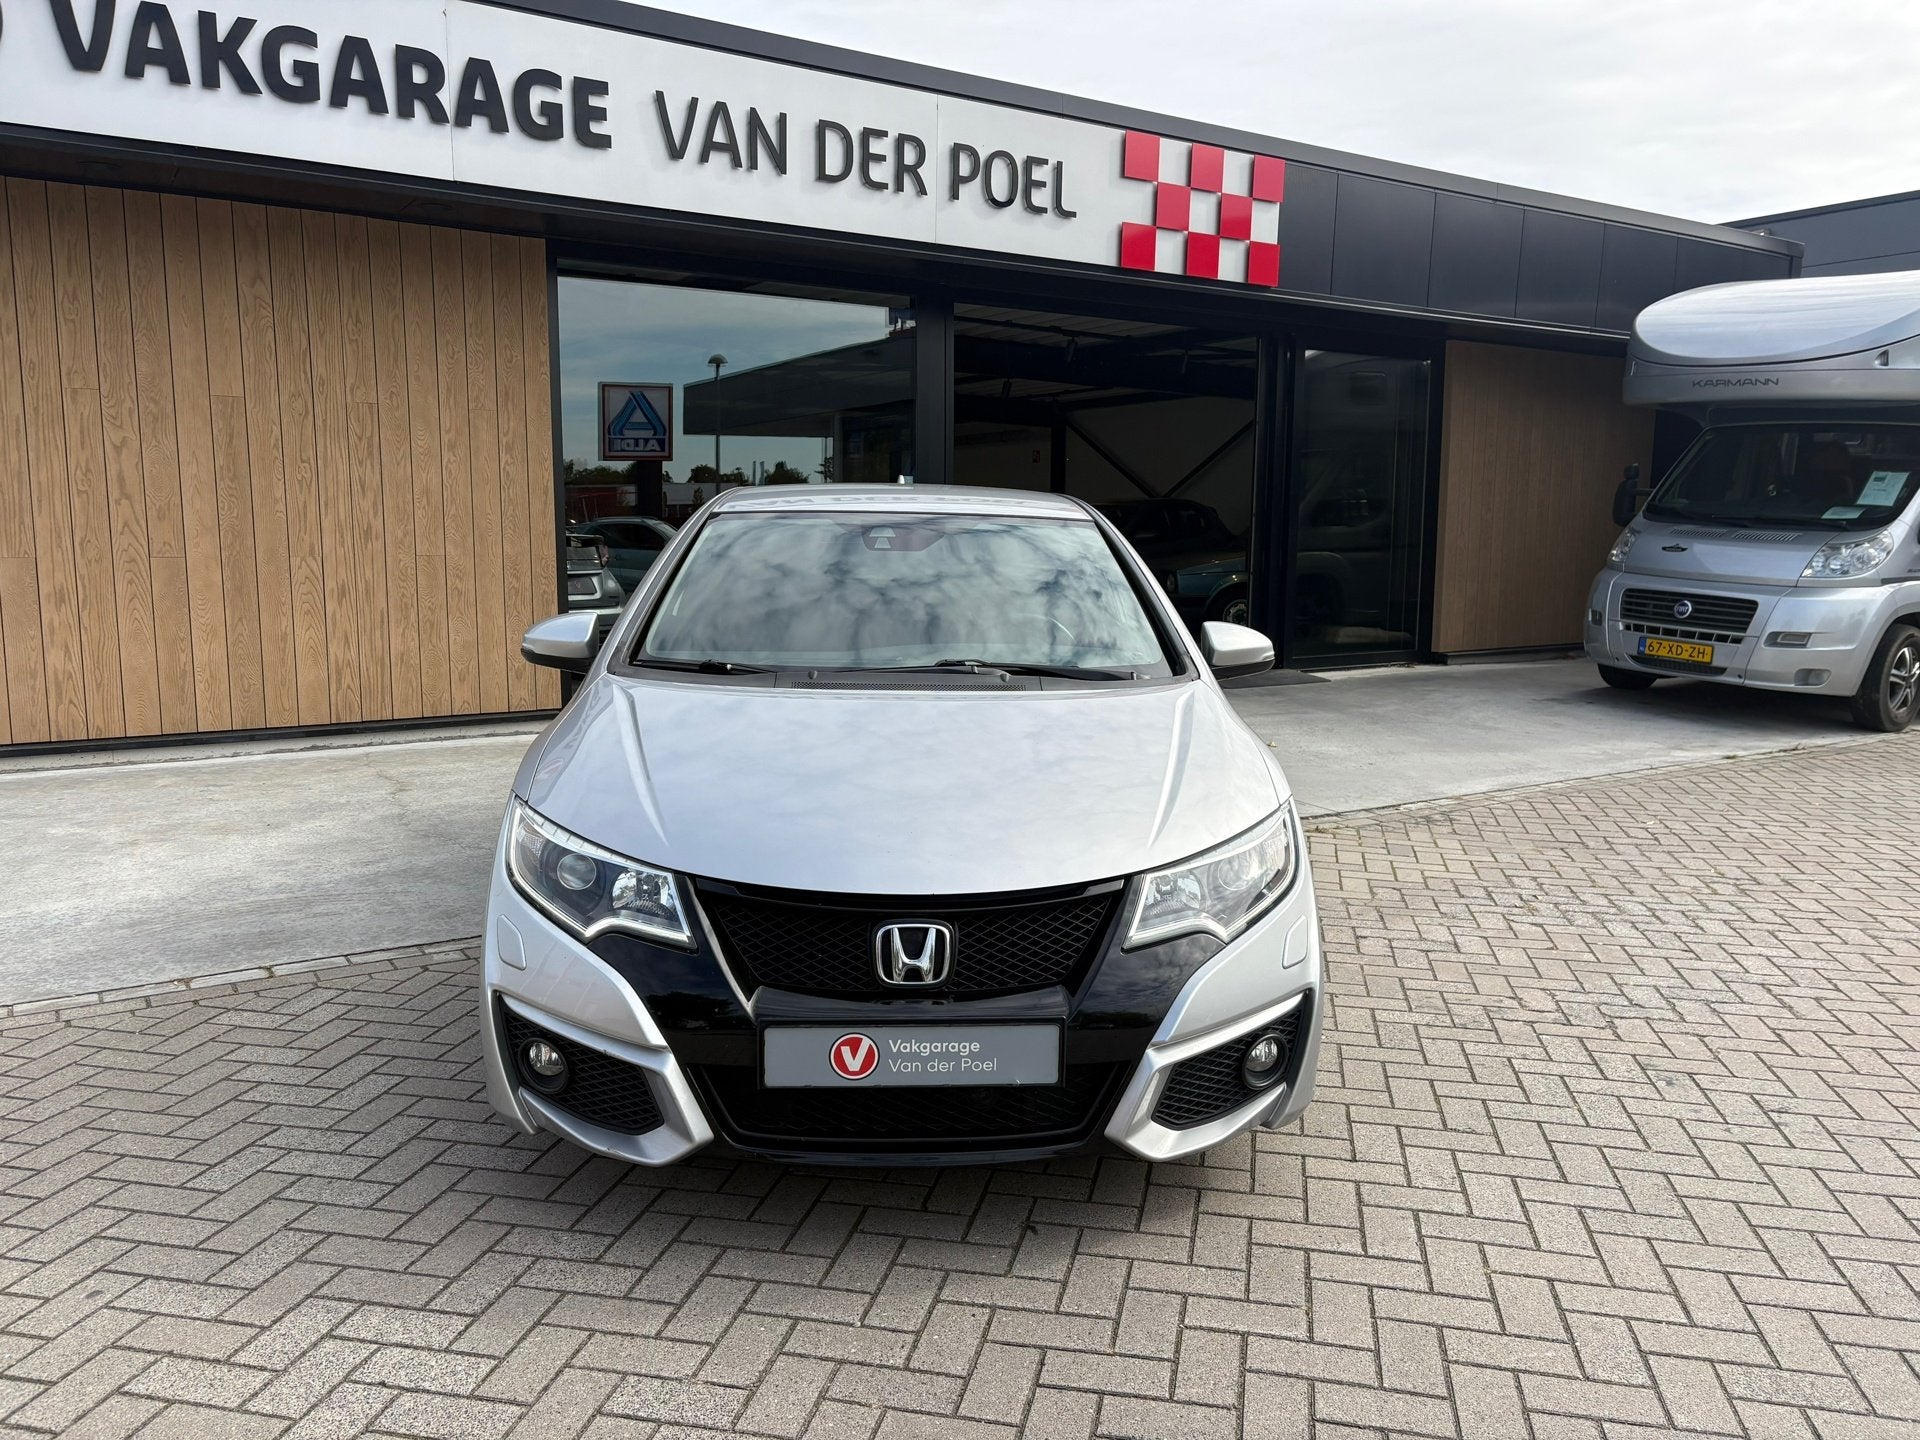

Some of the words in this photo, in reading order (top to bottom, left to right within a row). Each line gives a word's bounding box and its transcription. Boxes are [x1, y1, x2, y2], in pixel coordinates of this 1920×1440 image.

[51, 0, 612, 149] VAKGARAGE
[655, 90, 788, 175] VAN
[818, 119, 928, 197] DER
[950, 142, 1077, 219] POEL
[1692, 378, 1779, 388] KARMANN
[1648, 641, 1706, 659] 67-XD-ZH
[889, 1039, 980, 1056] Vakgarage
[888, 1059, 922, 1073] Van
[927, 1059, 955, 1072] der
[961, 1057, 997, 1071] Poel
